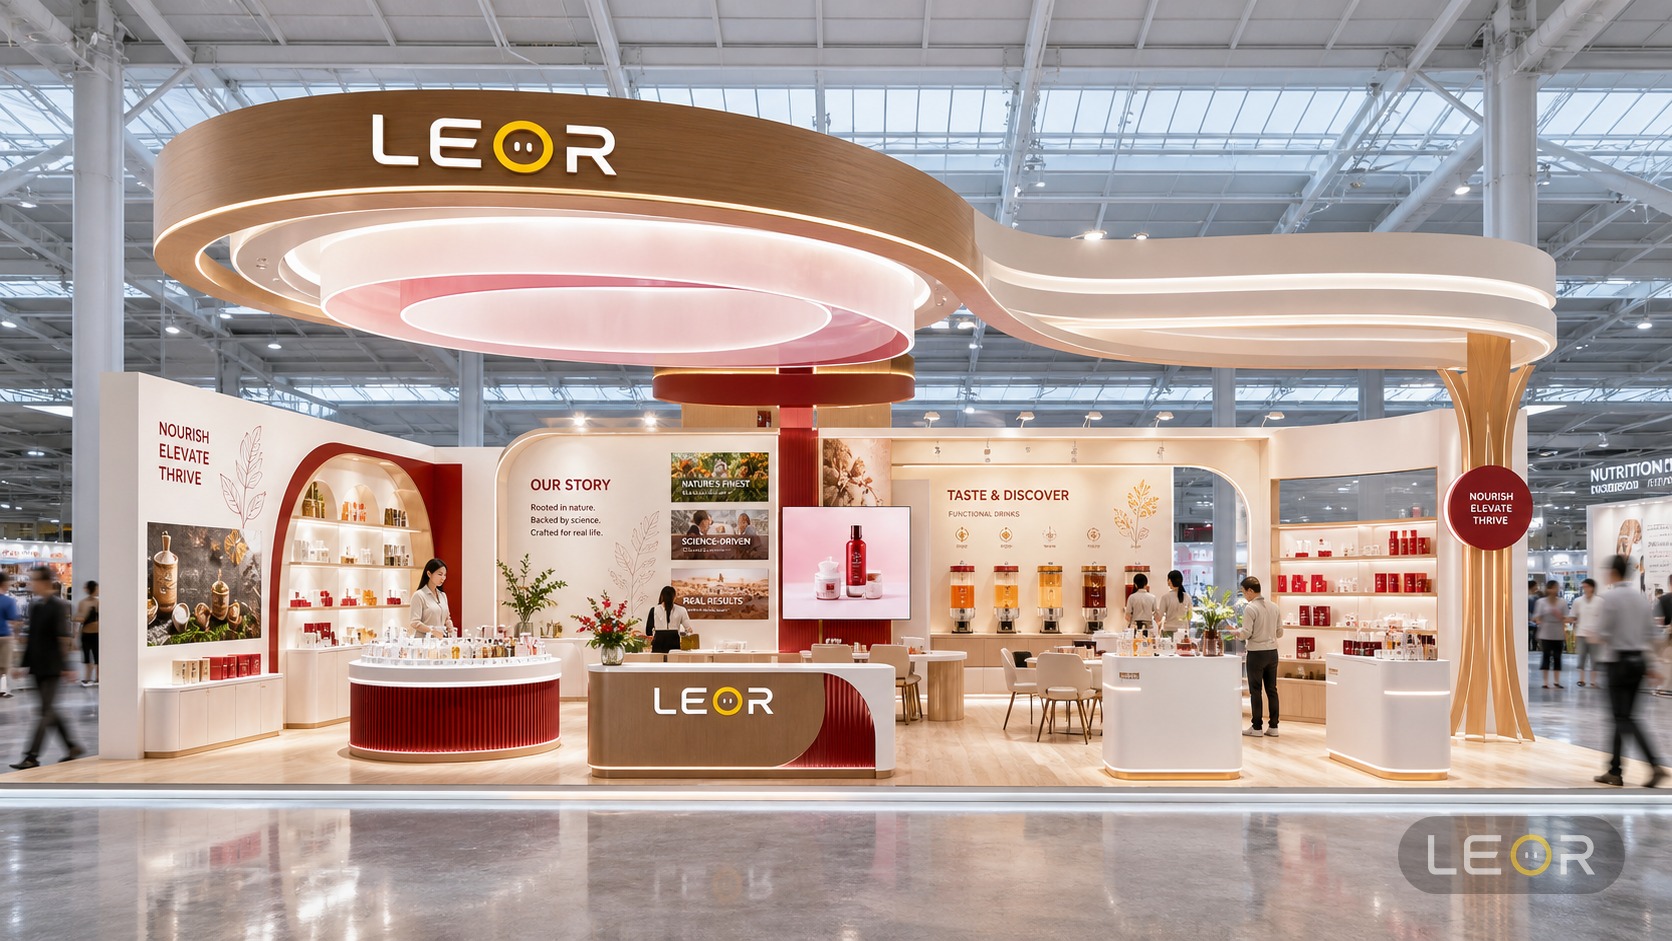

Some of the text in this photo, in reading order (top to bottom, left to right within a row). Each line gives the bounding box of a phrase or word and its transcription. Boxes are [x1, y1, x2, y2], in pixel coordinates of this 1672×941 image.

[372, 113, 617, 176] LEOR
[159, 421, 210, 444] NOURISH
[159, 443, 210, 465] ELEVATE
[159, 466, 202, 485] THRIVE
[1590, 459, 1662, 482] NUTRITION
[530, 479, 611, 491] OUR STORY
[947, 489, 1069, 501] TASTE & DISCOVER
[1469, 492, 1514, 501] NOURISH
[530, 503, 596, 512] Rooted in nature.
[1470, 504, 1513, 513] ELEVATE
[948, 510, 1020, 518] FUNCTIONAL DRINKS
[530, 516, 601, 526] Backed by science.
[1472, 516, 1509, 525] THRIVE
[530, 528, 603, 537] Crafted for real life.
[682, 597, 706, 605] REAL
[653, 687, 774, 716] LEOR
